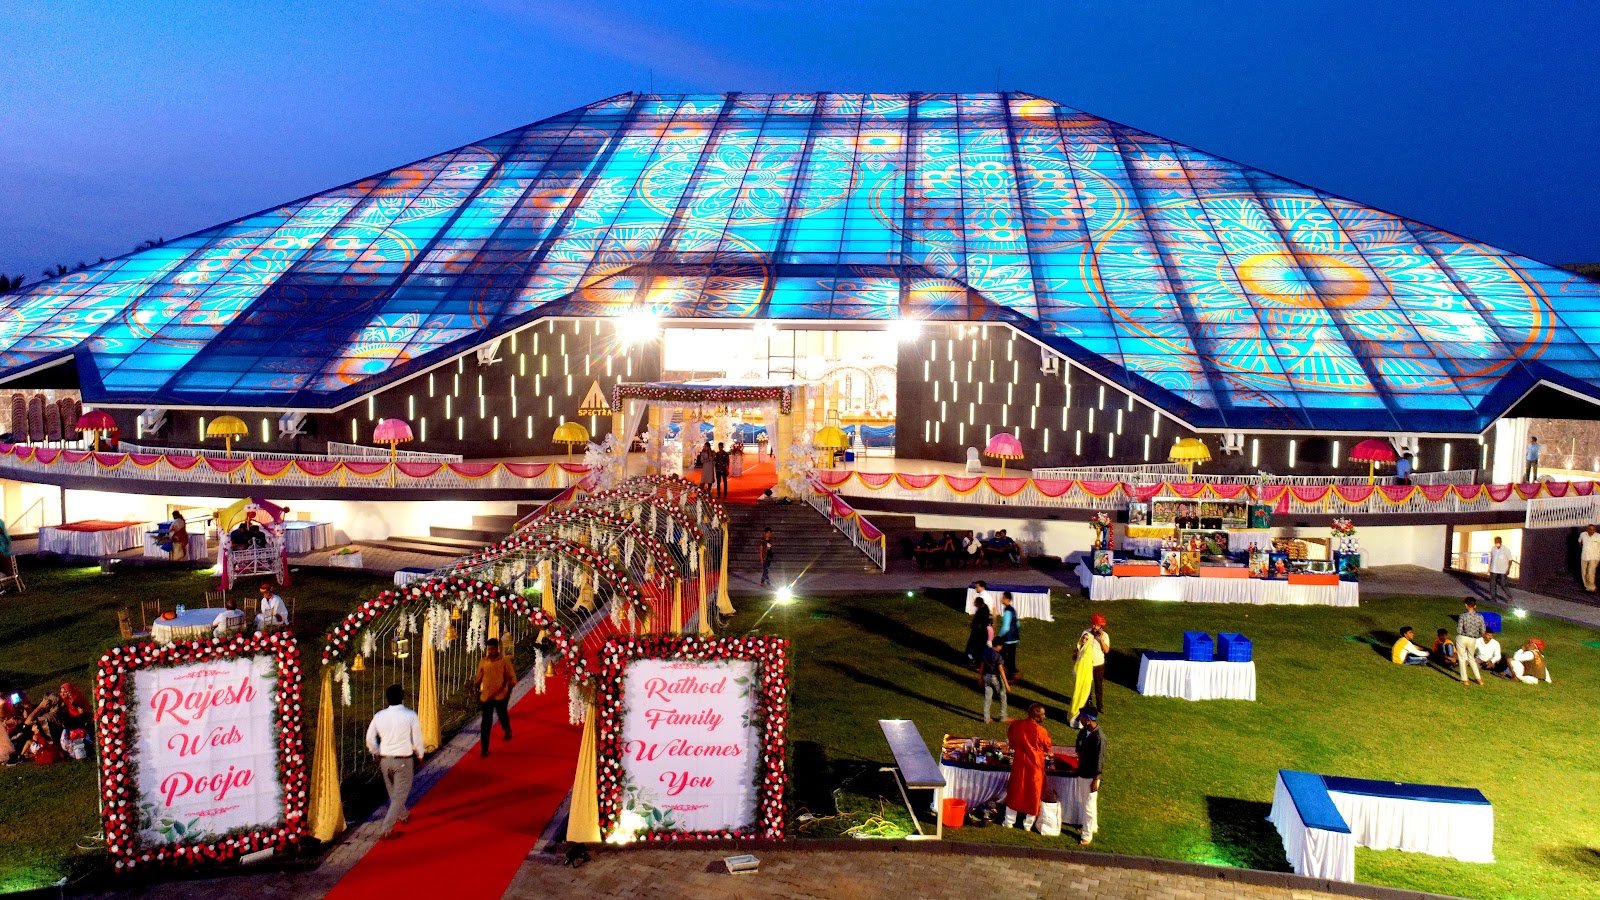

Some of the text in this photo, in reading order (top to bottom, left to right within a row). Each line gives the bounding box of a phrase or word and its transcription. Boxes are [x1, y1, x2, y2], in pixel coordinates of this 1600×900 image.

[150, 676, 257, 726] Rajesh
[644, 676, 727, 702] Rathod
[645, 708, 724, 731] Family
[167, 725, 243, 757] Weds
[624, 738, 742, 762] Welcomes
[160, 765, 254, 808] Pooja
[659, 771, 714, 796] You
